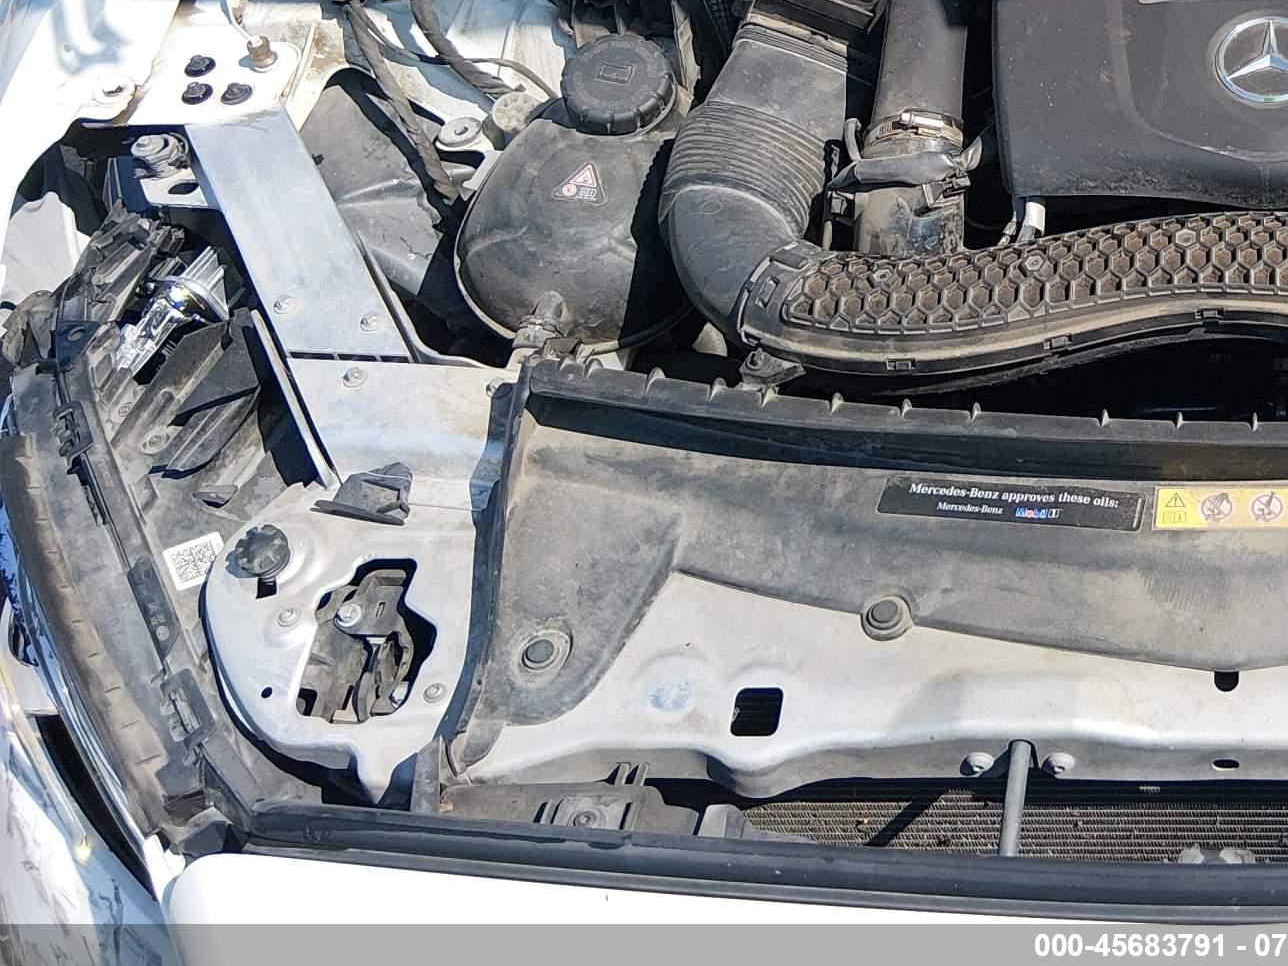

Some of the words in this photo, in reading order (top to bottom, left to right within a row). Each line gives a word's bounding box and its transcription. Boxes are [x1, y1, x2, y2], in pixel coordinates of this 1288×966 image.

[908, 483, 1000, 499] Mercedes-Benz
[1001, 492, 1056, 503] approves
[1058, 491, 1091, 504] these
[1093, 497, 1119, 508] oils:
[936, 501, 1004, 515] Mercedes-Benz
